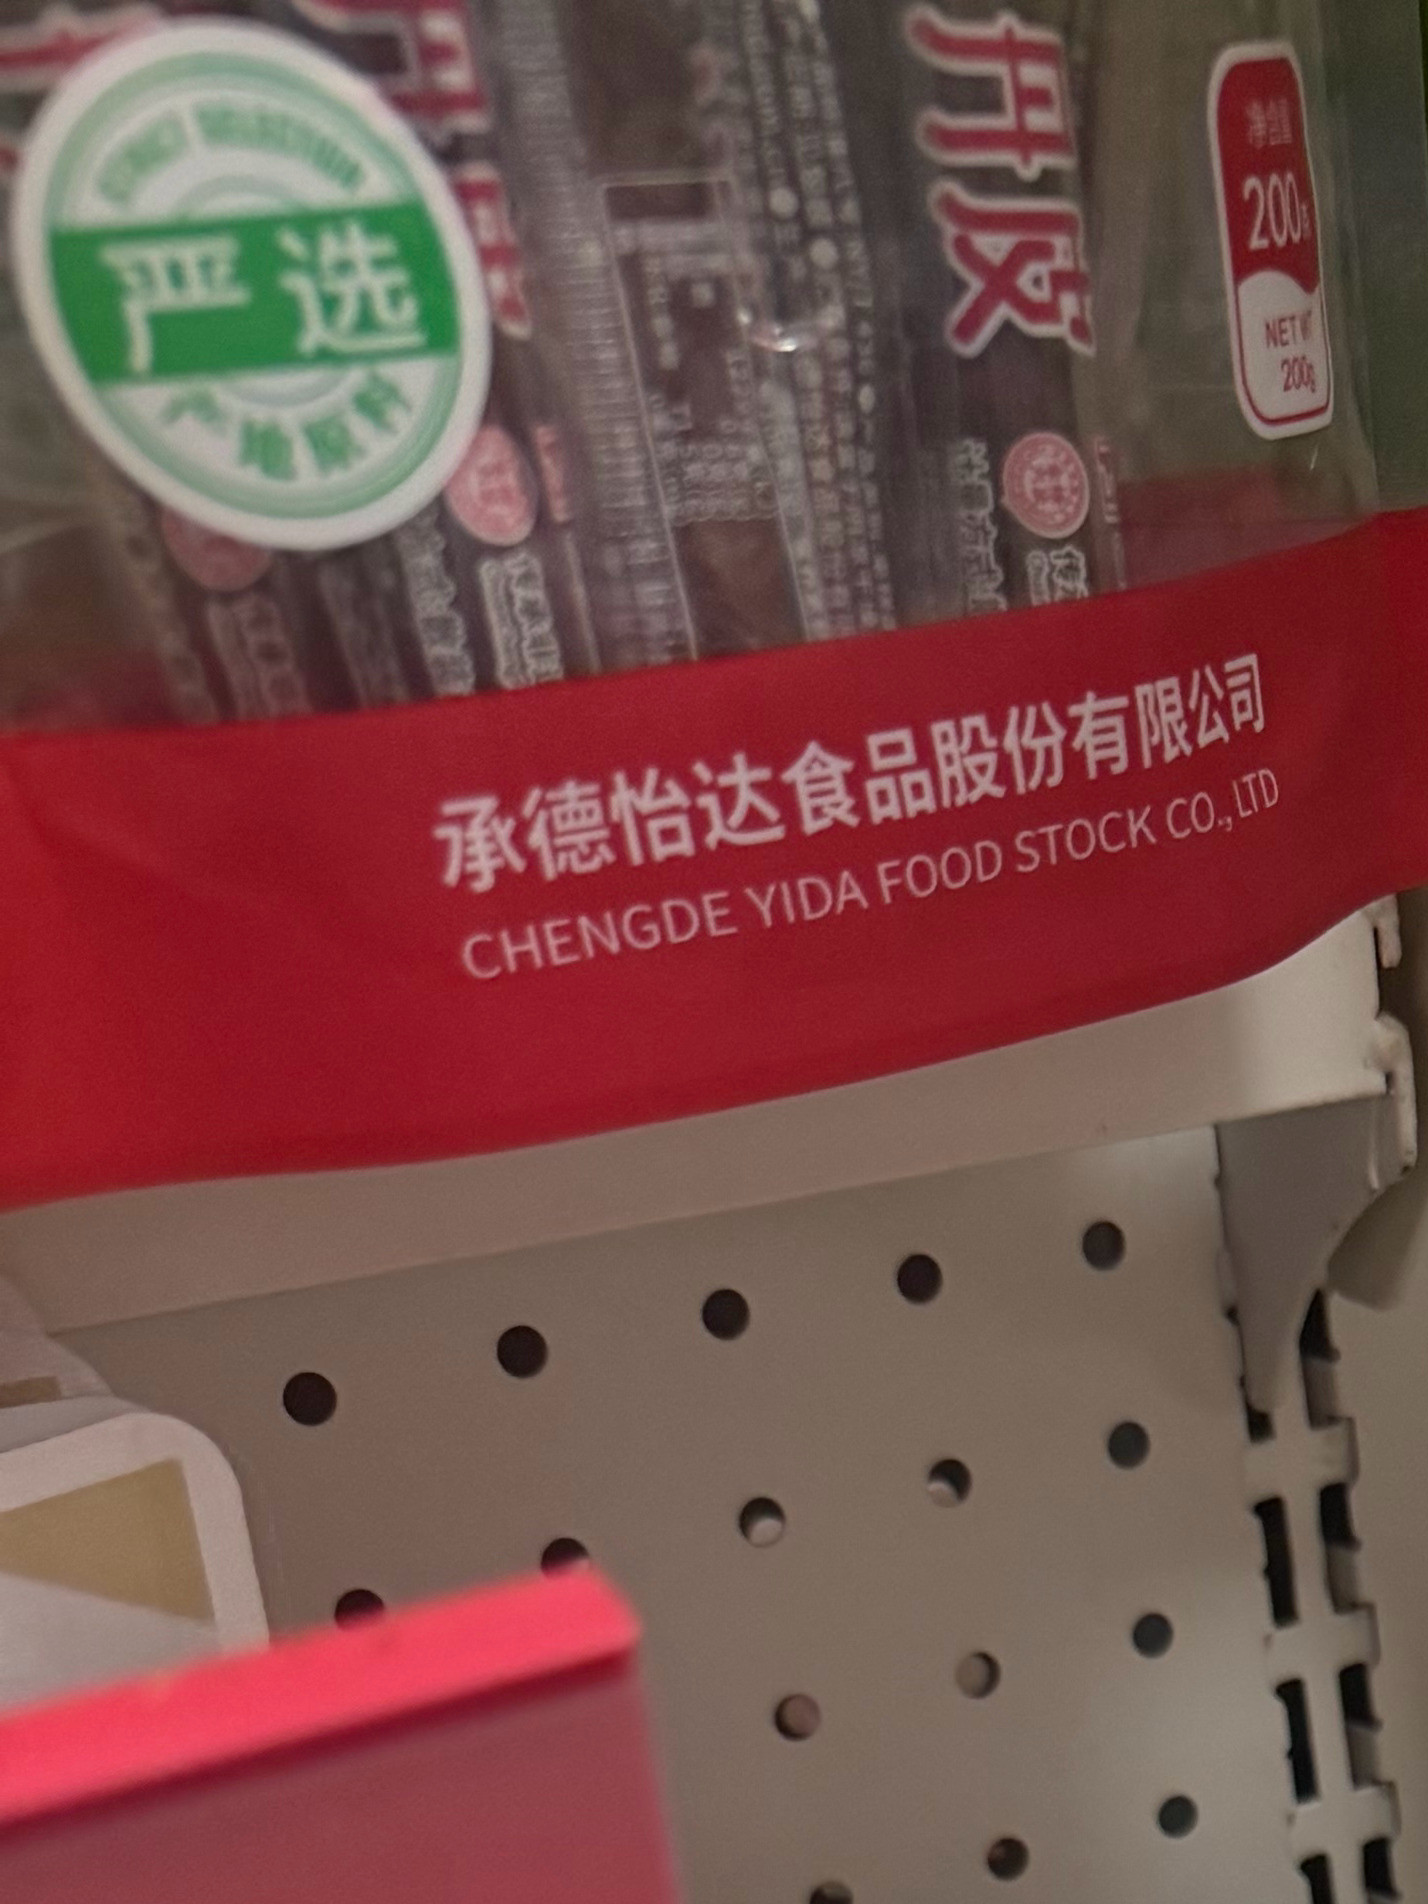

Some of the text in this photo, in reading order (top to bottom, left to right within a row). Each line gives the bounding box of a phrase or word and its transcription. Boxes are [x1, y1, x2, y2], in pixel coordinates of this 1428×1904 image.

[100, 219, 428, 374] 严选
[1264, 316, 1297, 350] NET
[431, 652, 1267, 897] 承德怡达食品股份有限公司
[462, 889, 737, 980] CHENGDE
[743, 873, 868, 930] YIDA
[878, 840, 1003, 901] FOOD
[1014, 806, 1158, 875] STOCK
